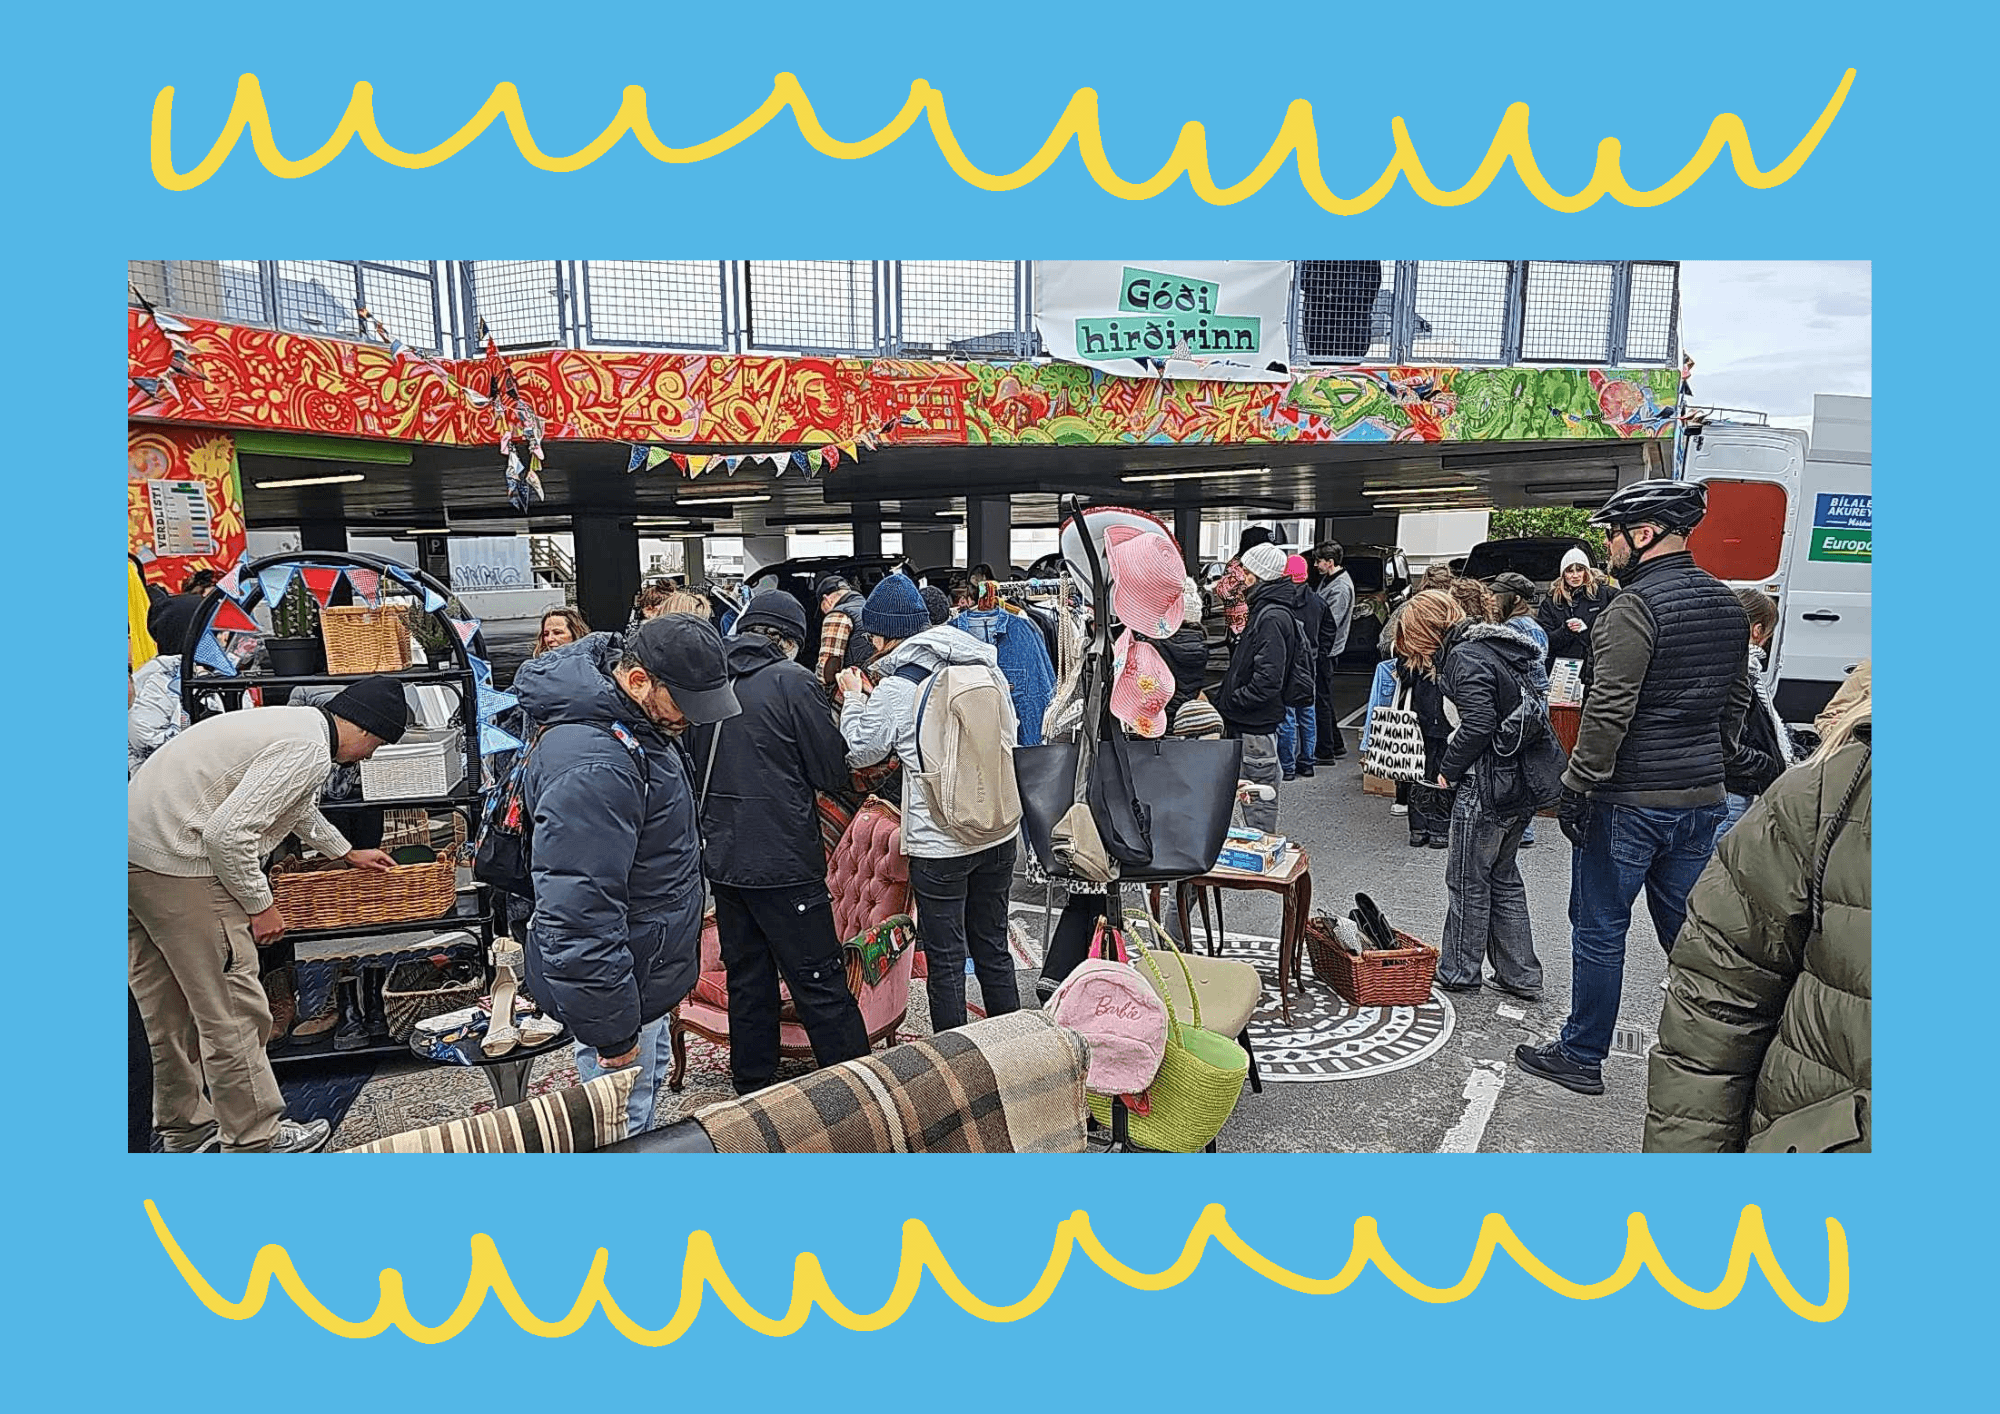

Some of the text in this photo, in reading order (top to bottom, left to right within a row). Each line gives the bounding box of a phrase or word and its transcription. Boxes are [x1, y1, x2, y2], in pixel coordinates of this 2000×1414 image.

[1127, 278, 1212, 314] Góði
[1081, 319, 1255, 354] hirðirinn
[152, 487, 167, 549] VERDLISTI
[1093, 995, 1142, 1020] Barbie
